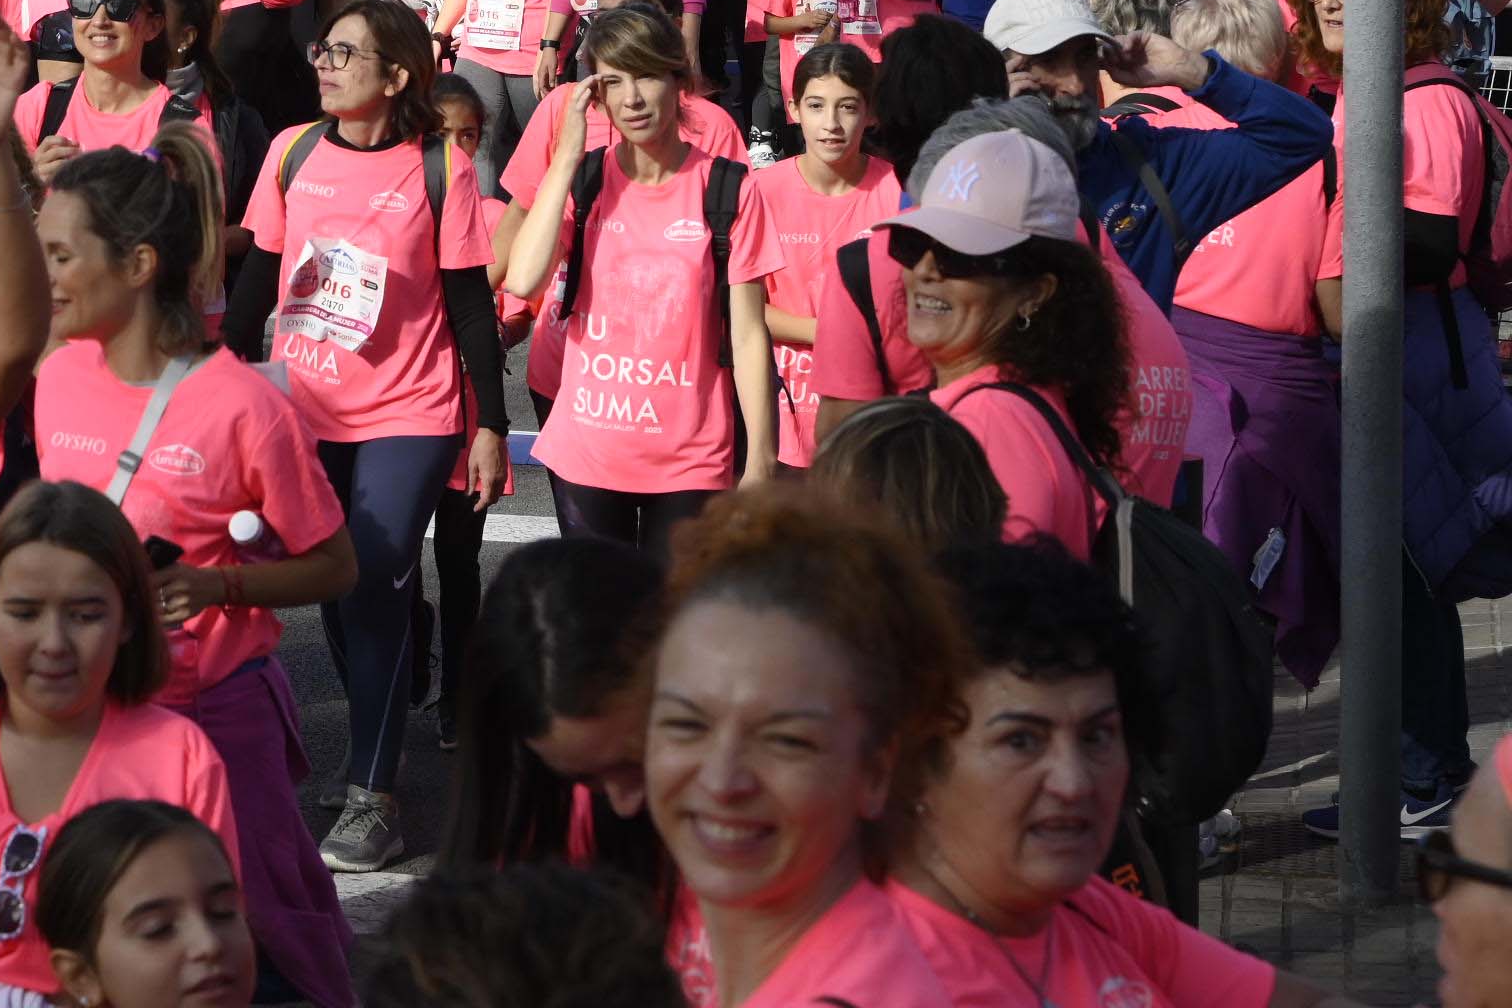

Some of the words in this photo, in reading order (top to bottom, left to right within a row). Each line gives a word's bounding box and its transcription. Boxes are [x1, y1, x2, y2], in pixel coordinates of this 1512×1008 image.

[479, 10, 499, 20] 016
[321, 277, 352, 299] 016
[283, 332, 339, 376] UMA
[573, 386, 659, 424] SUMA
[1140, 393, 1166, 416] DE
[51, 432, 106, 454] OYSHO
[1130, 421, 1186, 446] MUJE
